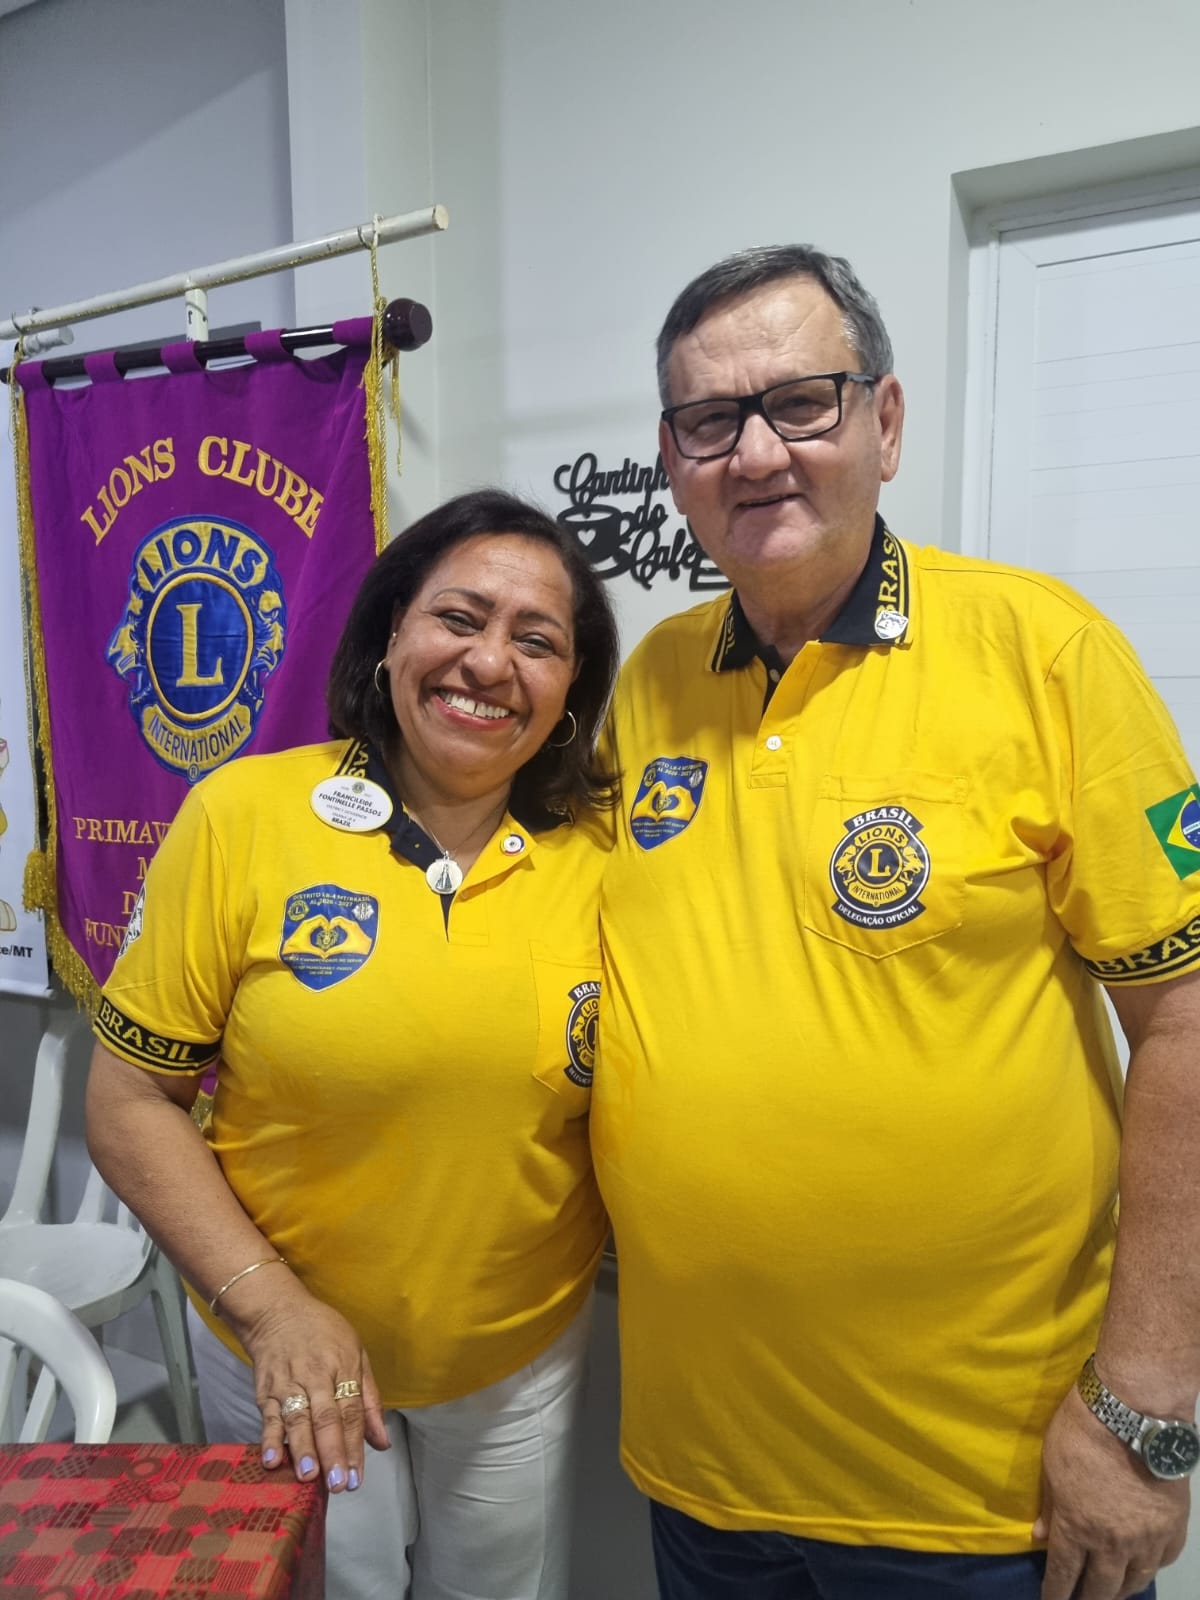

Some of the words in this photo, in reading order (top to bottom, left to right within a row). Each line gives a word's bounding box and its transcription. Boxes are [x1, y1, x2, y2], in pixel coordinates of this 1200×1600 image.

[80, 437, 176, 546] LIONS
[198, 435, 325, 539] CLUBE
[139, 528, 262, 587] LIONS
[175, 601, 225, 688] L
[147, 712, 246, 763] INTERNATIONAL
[852, 807, 914, 829] BRASIL
[858, 827, 906, 845] LIONS
[867, 848, 892, 877] L
[852, 885, 903, 901] INTERNATIONAL
[838, 903, 885, 926] DELEGAÇÃO
[885, 904, 919, 924] OFICIAL
[0, 944, 33, 958] e/MT
[100, 1001, 195, 1062] BRASIL
